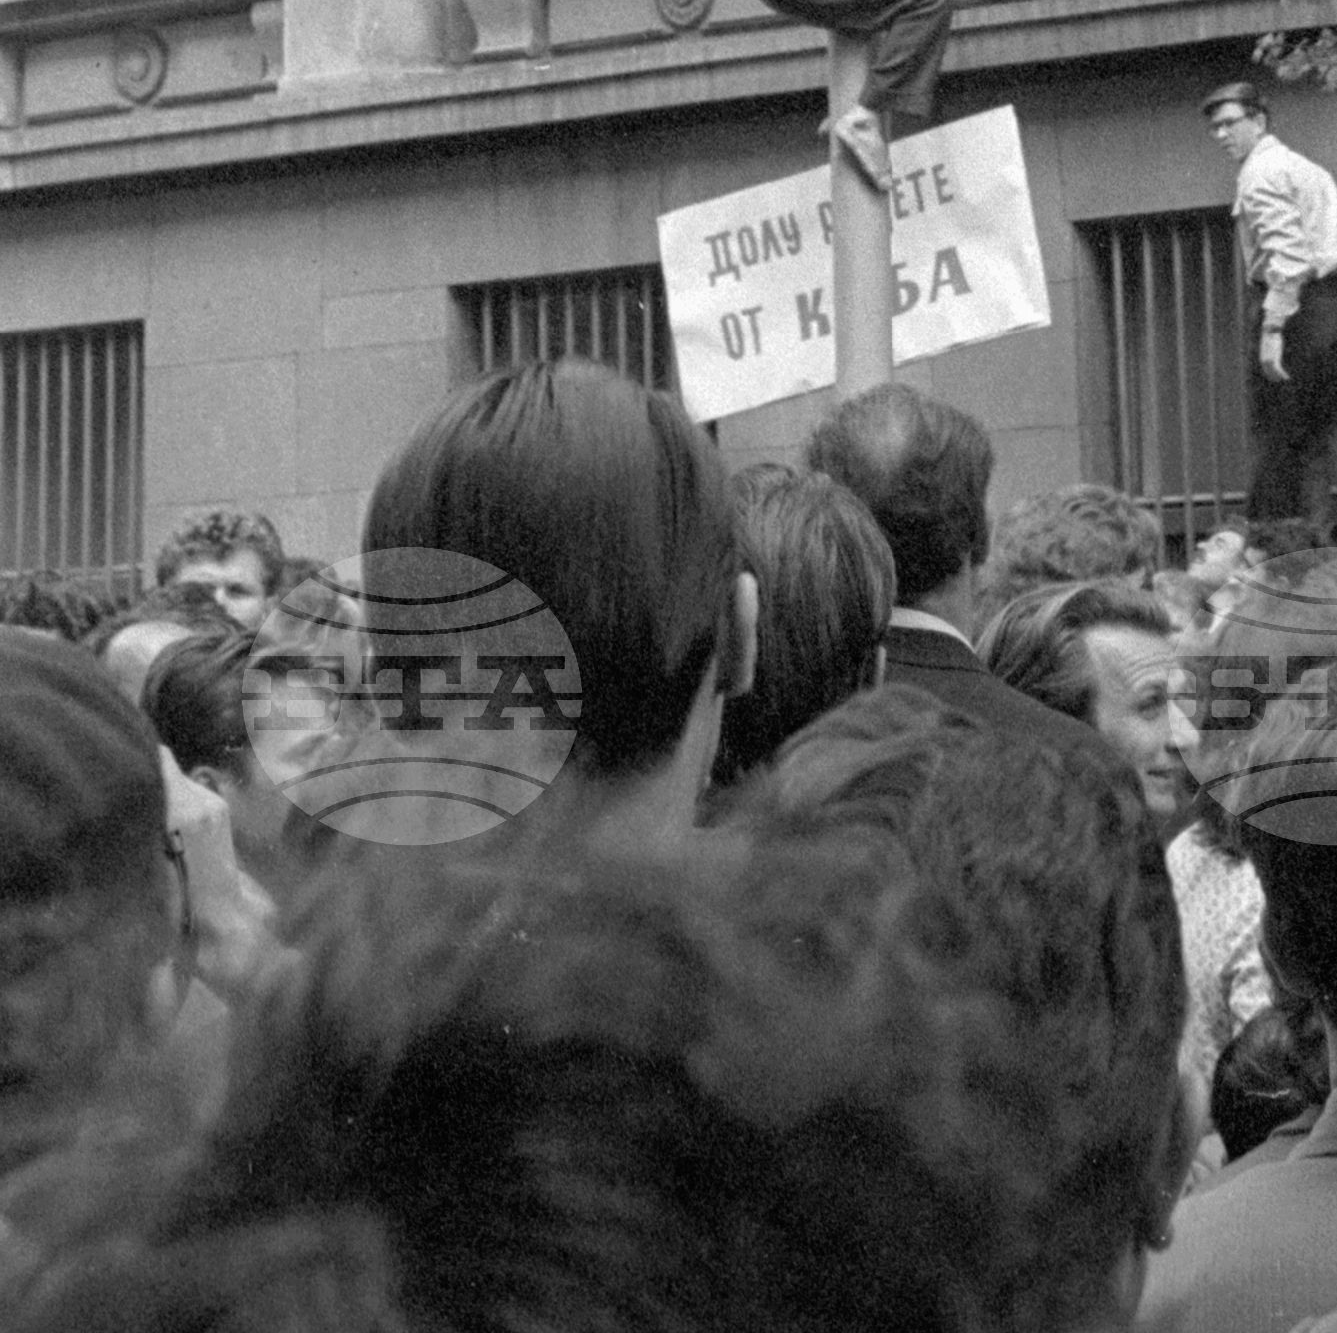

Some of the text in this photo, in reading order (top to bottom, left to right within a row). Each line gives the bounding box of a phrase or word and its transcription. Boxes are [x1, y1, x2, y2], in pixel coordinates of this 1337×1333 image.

[704, 212, 801, 287] ДОЛУ
[719, 245, 972, 361] ОТ КБА
